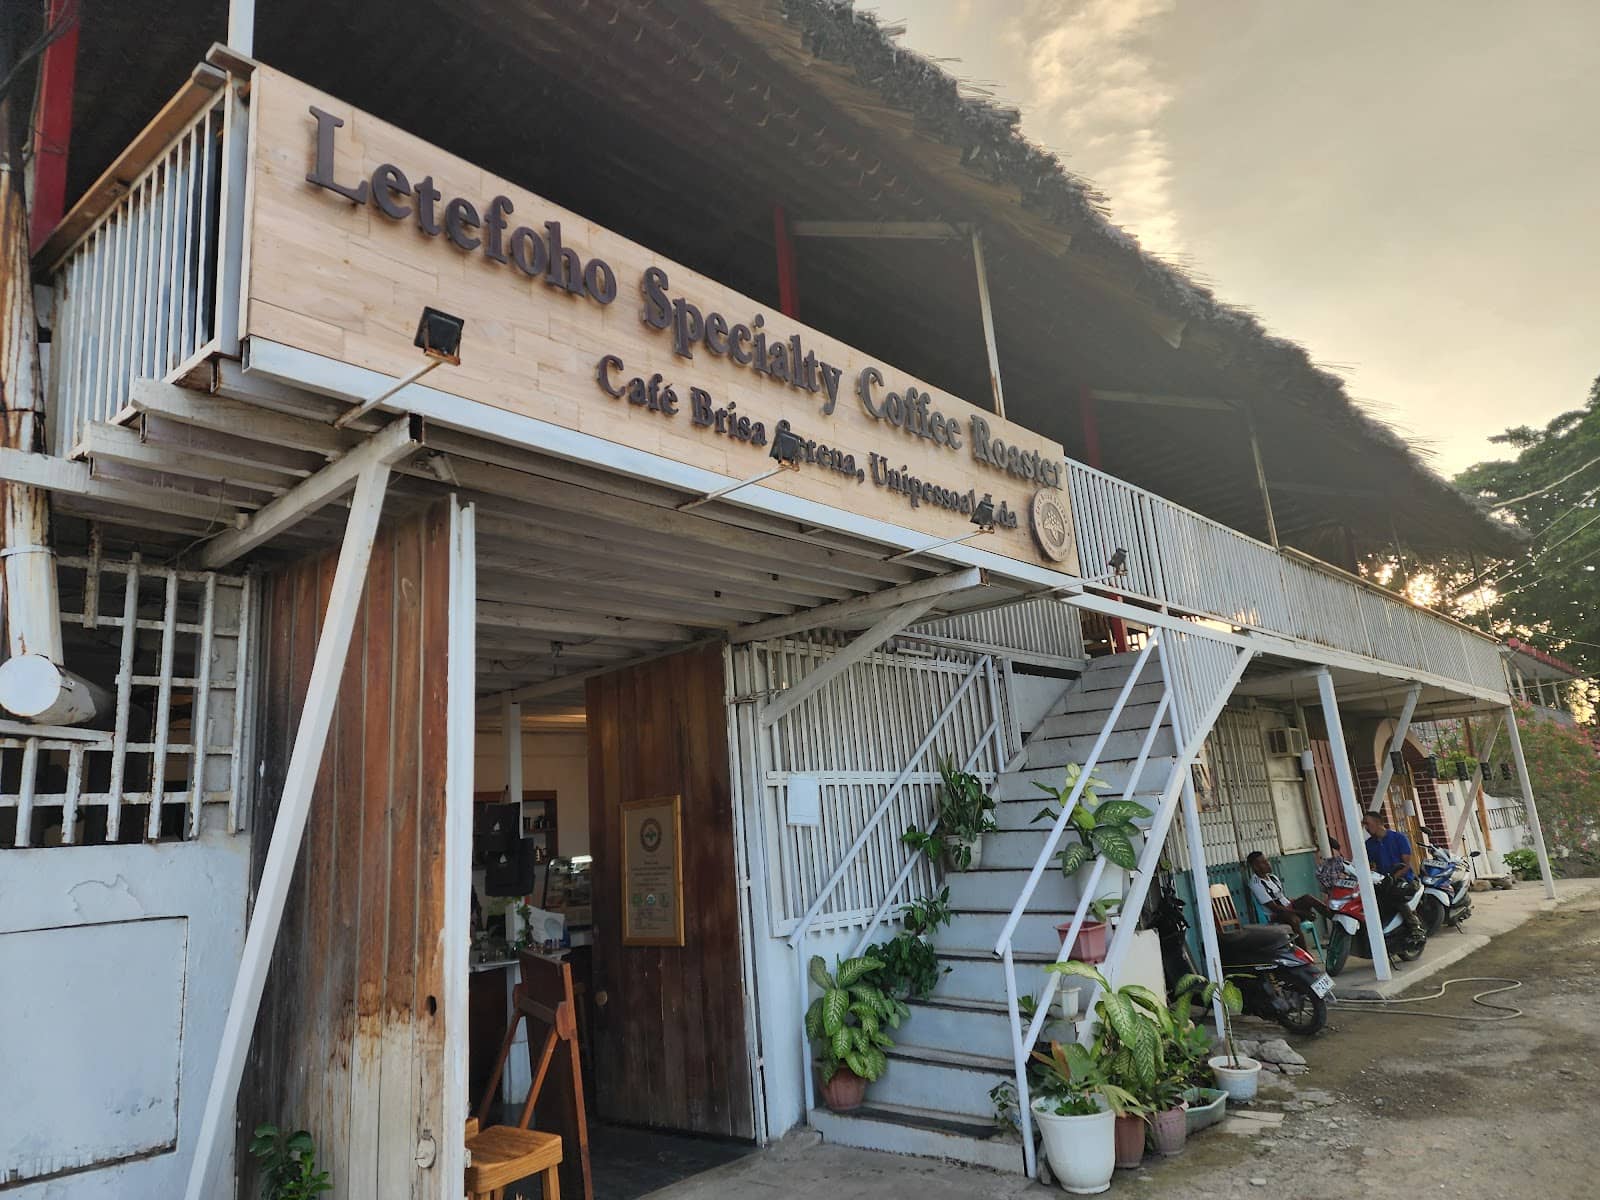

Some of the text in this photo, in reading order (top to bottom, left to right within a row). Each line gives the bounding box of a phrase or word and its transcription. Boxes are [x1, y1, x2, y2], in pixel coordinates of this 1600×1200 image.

[306, 105, 1063, 490] Letefoho Specialty Coffee Roaster
[598, 354, 679, 415] Café
[690, 386, 768, 446] Brisa
[775, 420, 865, 483] rena,
[868, 451, 976, 513] Unipessoal
